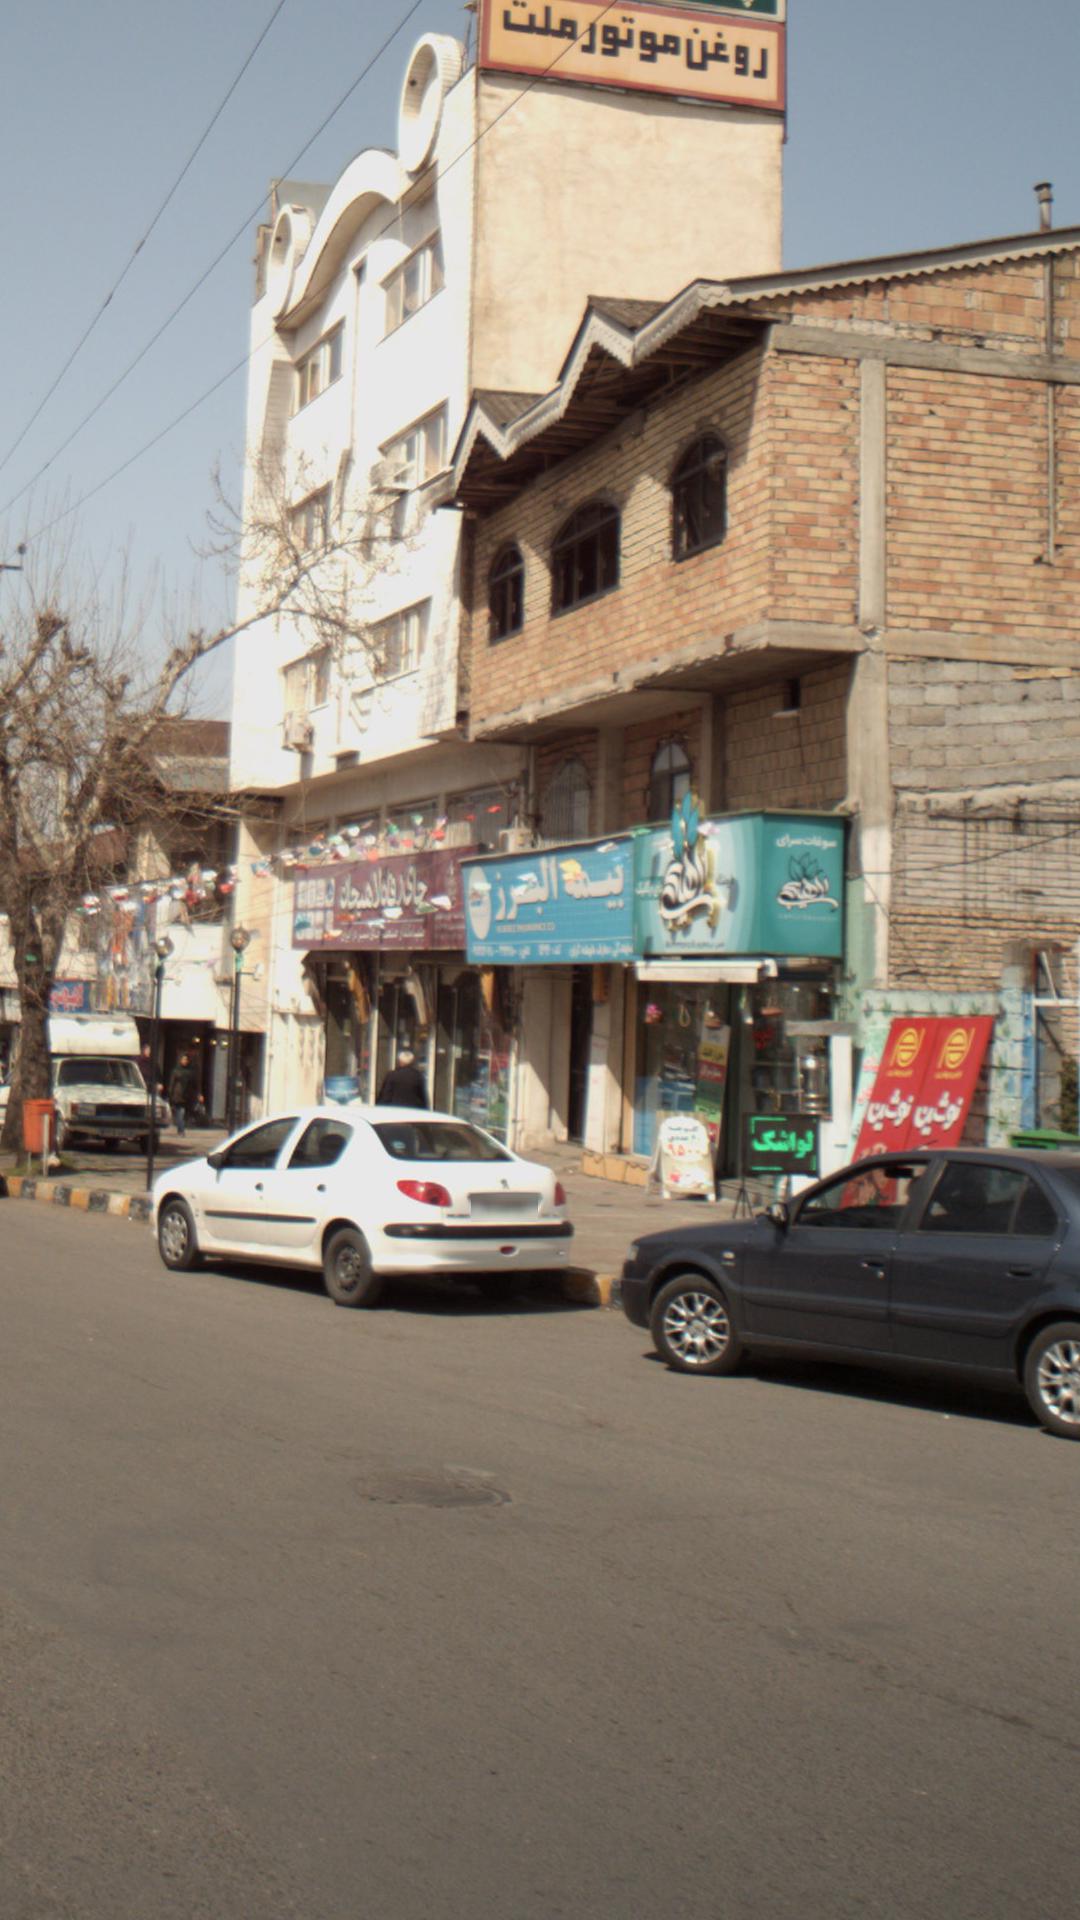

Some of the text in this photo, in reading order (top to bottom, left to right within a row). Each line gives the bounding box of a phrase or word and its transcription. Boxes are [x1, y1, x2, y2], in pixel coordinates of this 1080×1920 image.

[502, 0, 768, 79] روغن موتور ملت
[752, 1129, 814, 1159] لواشک
